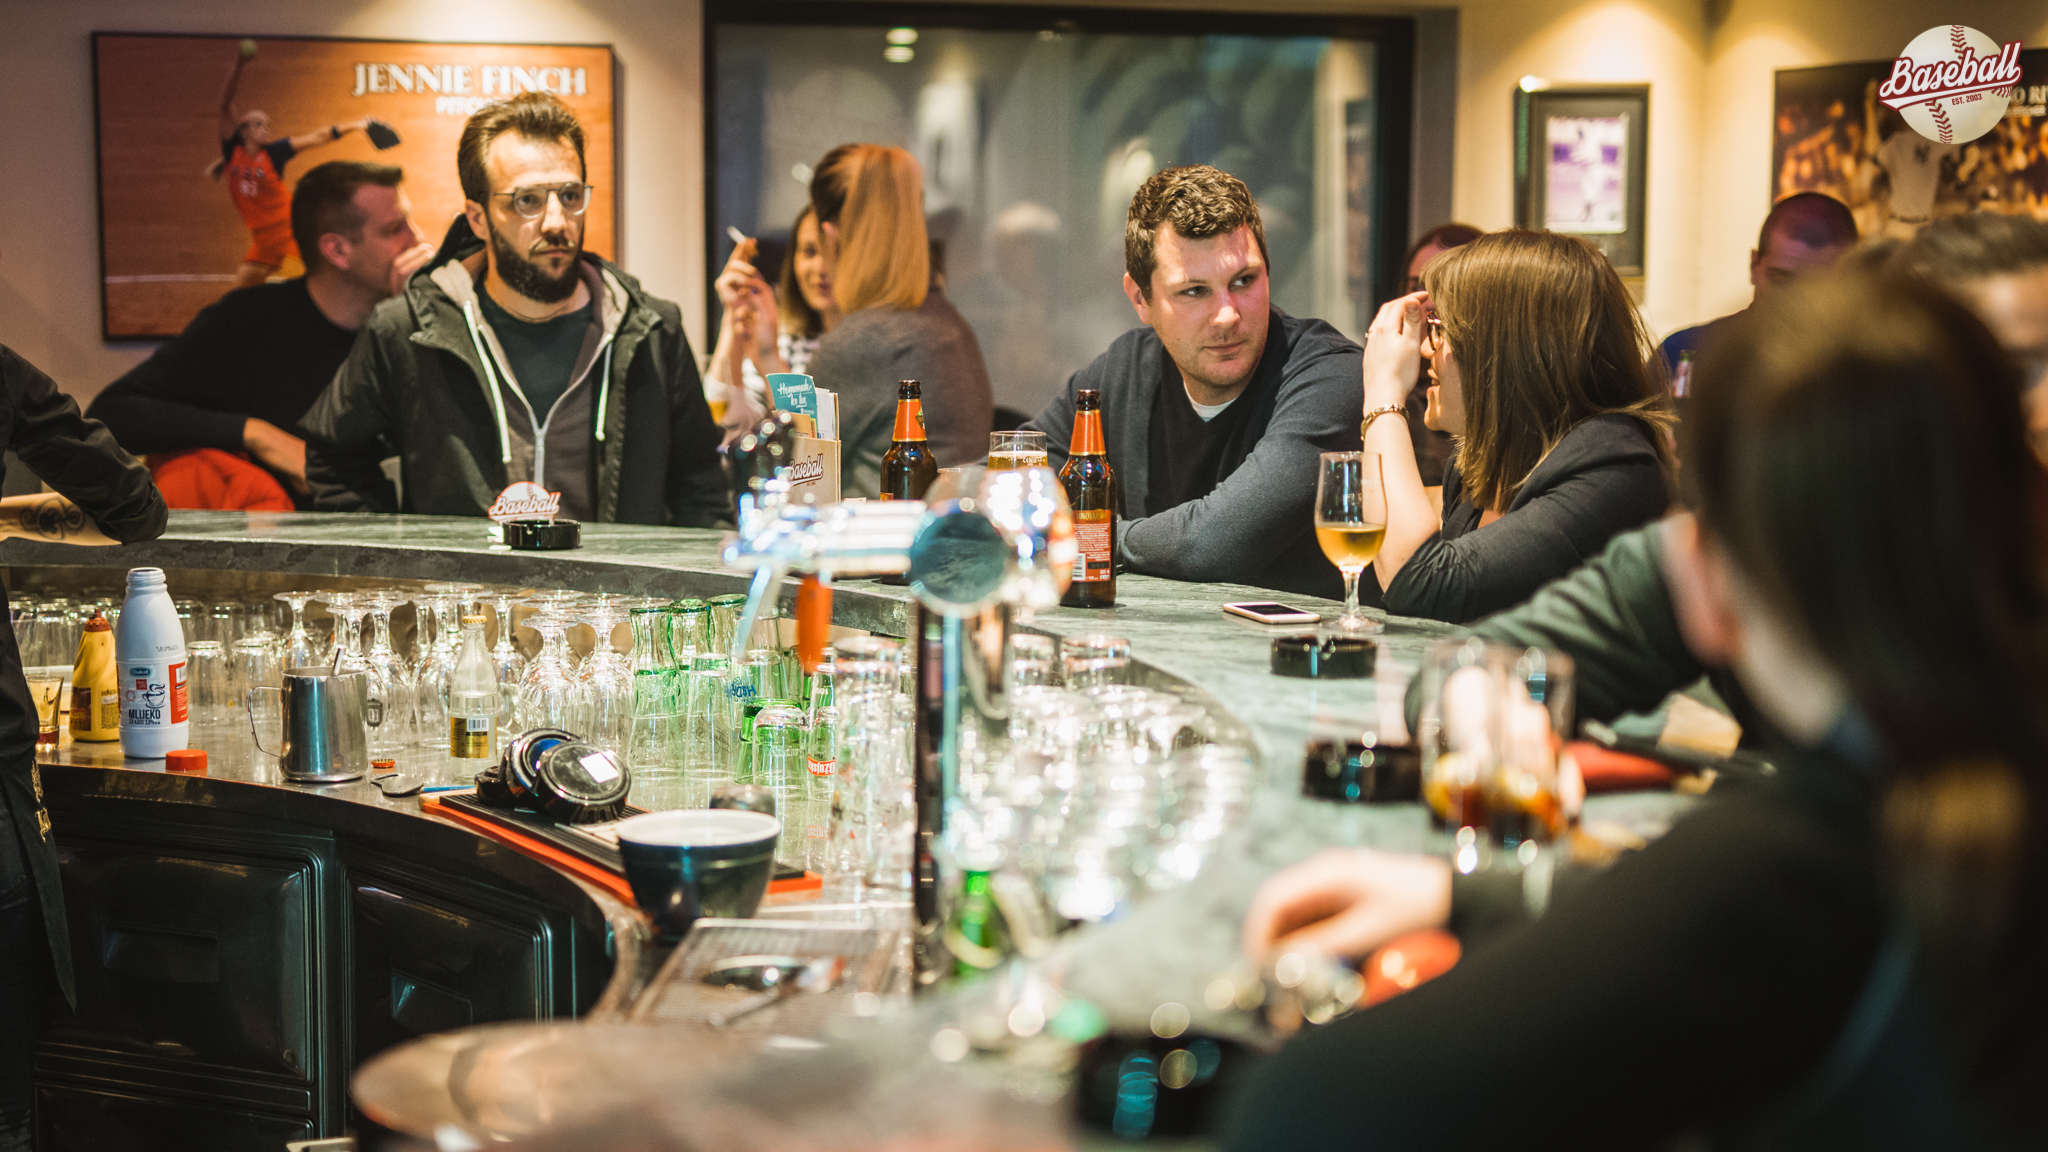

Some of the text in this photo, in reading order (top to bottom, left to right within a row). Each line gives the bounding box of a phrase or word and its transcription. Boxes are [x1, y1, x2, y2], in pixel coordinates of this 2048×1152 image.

[352, 63, 588, 97] JENNIE FINCH
[777, 378, 813, 396] Homemade
[789, 453, 823, 480] Baseball
[489, 493, 561, 515] Baseball
[128, 709, 161, 720] MLIJEKO
